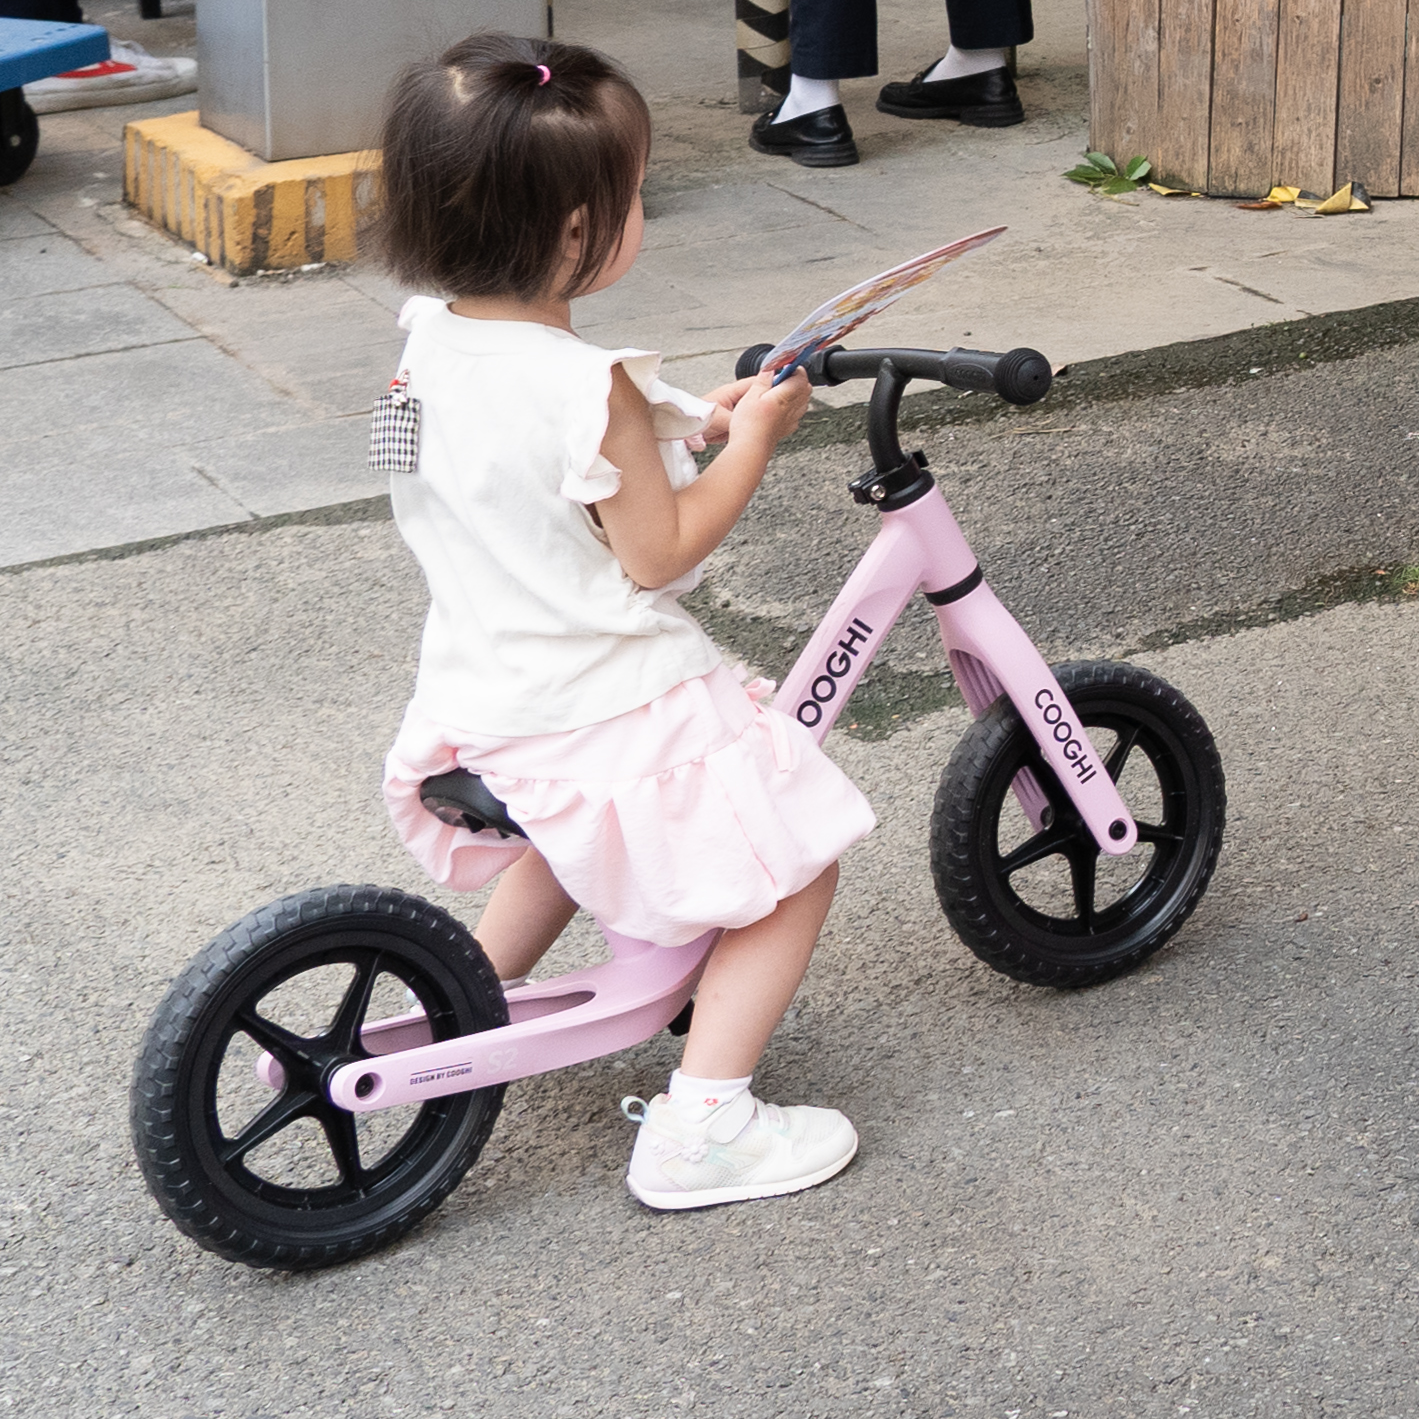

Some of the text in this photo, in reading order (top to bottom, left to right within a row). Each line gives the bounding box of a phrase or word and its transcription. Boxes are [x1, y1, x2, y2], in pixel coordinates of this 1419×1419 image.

[1034, 687, 1098, 786] COOGHI
[409, 1067, 473, 1085] DESIGN BY COOGHI
